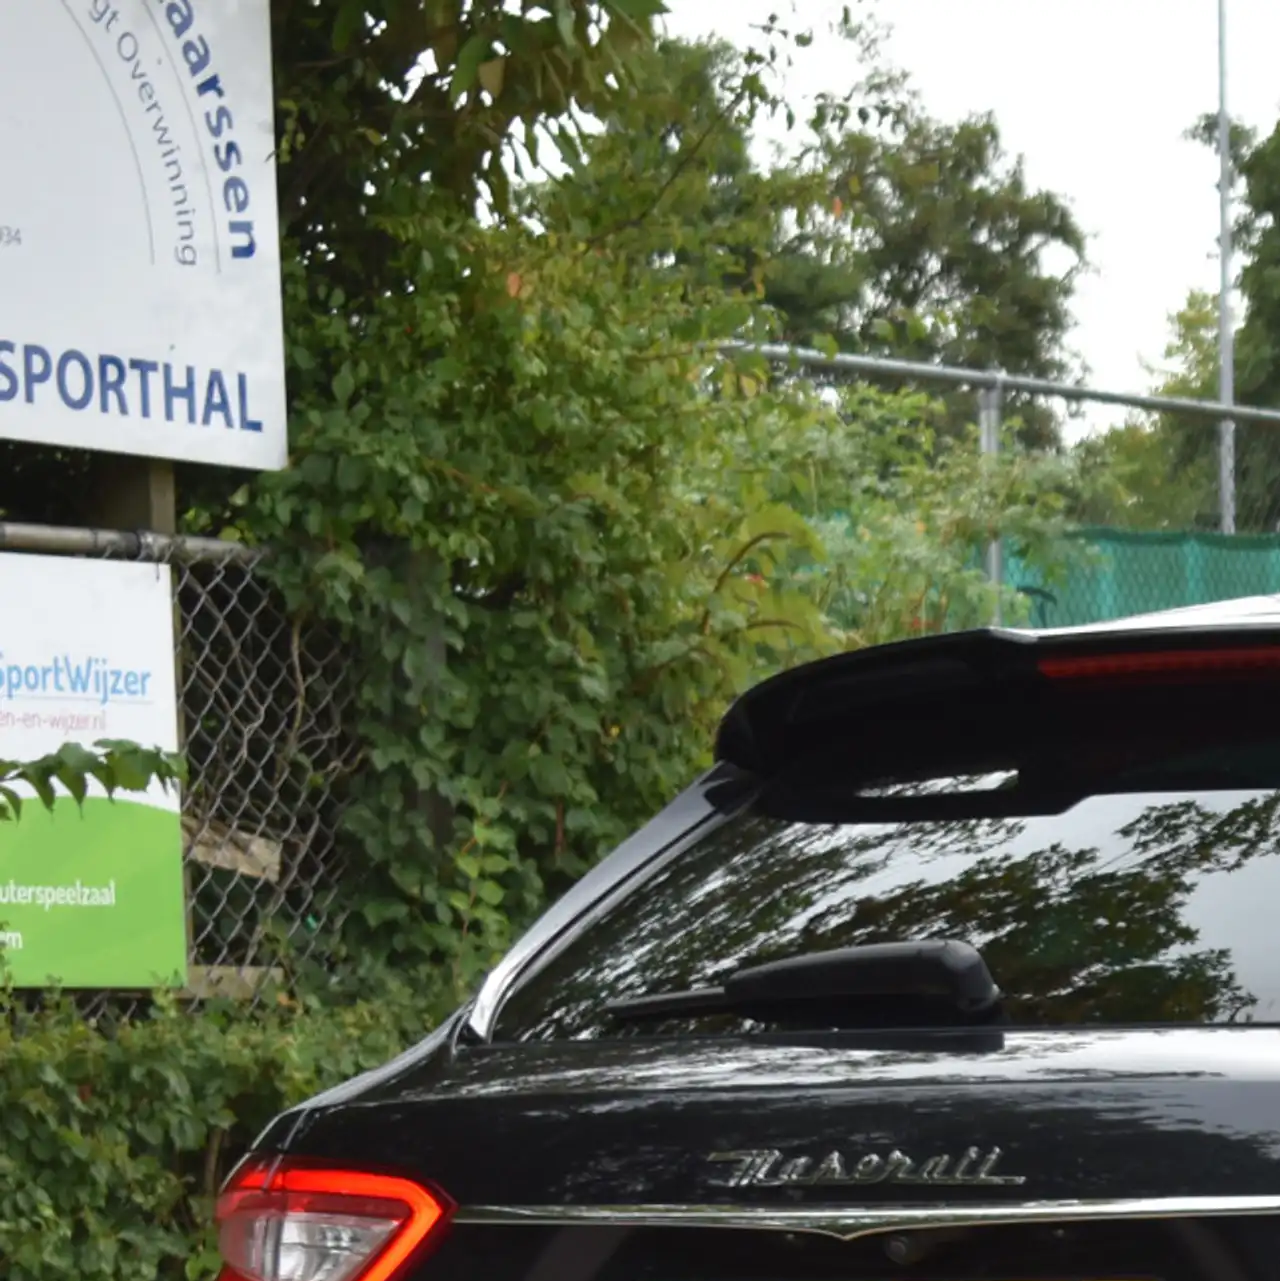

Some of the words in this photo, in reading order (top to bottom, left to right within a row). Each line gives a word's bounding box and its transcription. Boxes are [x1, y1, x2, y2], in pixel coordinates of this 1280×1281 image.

[117, 31, 197, 267] Overwinning
[157, 0, 258, 260] aarssen
[0, 339, 264, 433] SPORTHAL
[0, 655, 152, 705] portWijzer
[706, 1145, 1027, 1188] Maserati
